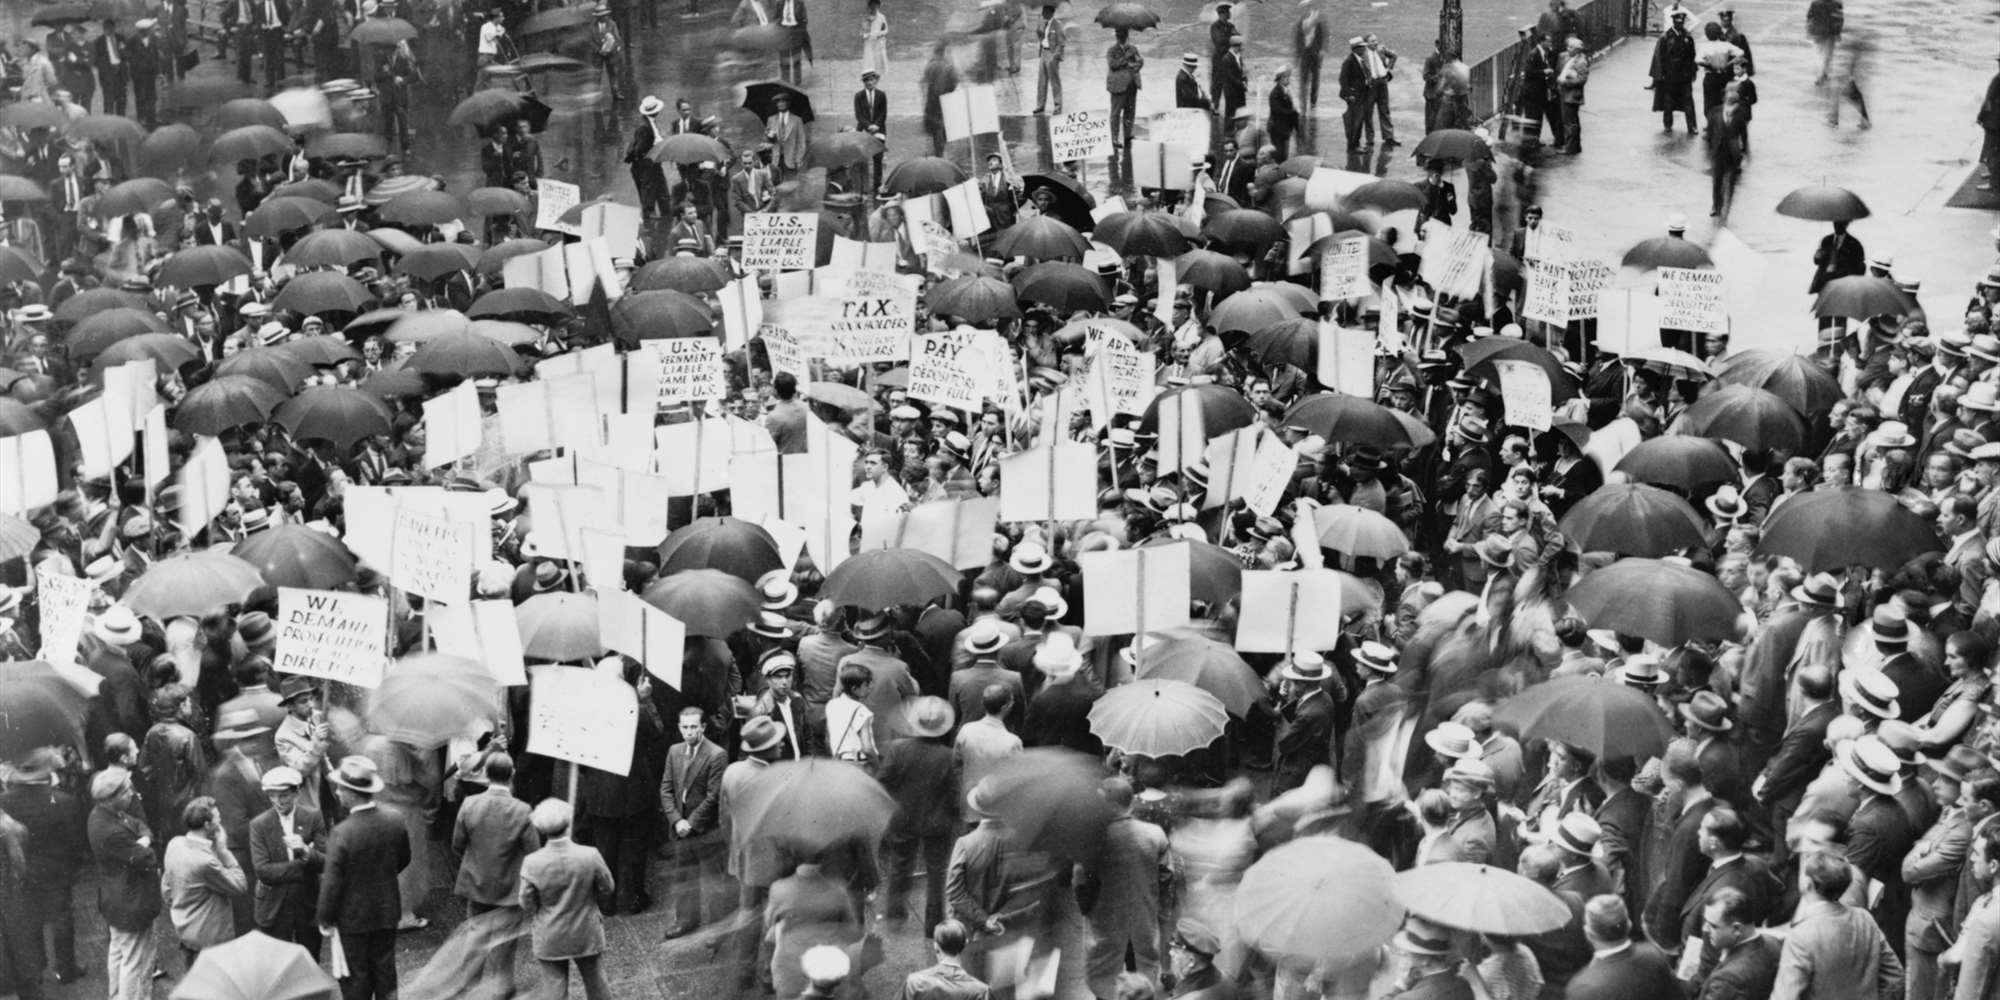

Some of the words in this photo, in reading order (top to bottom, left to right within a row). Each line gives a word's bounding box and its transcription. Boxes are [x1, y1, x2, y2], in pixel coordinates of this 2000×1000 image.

[1066, 111, 1088, 124] NO
[1054, 119, 1107, 134] EVICTIONS
[1067, 145, 1094, 157] RENT
[768, 216, 802, 228] U.S.
[746, 228, 814, 237] GOVERNMENT
[760, 238, 803, 247] LIABLE
[759, 248, 780, 256] NAME
[744, 257, 770, 266] BANK
[1542, 260, 1565, 280] WANT
[1662, 270, 1676, 280] WE
[1680, 272, 1723, 284] DEMAND
[842, 298, 892, 318] TAX
[1088, 326, 1104, 340] WE
[1106, 338, 1130, 351] ARE
[672, 340, 706, 354] U.S.
[924, 338, 963, 360] PAY
[660, 352, 716, 364] VERNMENT
[663, 364, 702, 376] LIABLE
[692, 372, 714, 382] WAS
[658, 387, 678, 397] ANK
[692, 384, 717, 397] U.S.
[910, 382, 941, 396] FIRST
[946, 387, 972, 400] FULL
